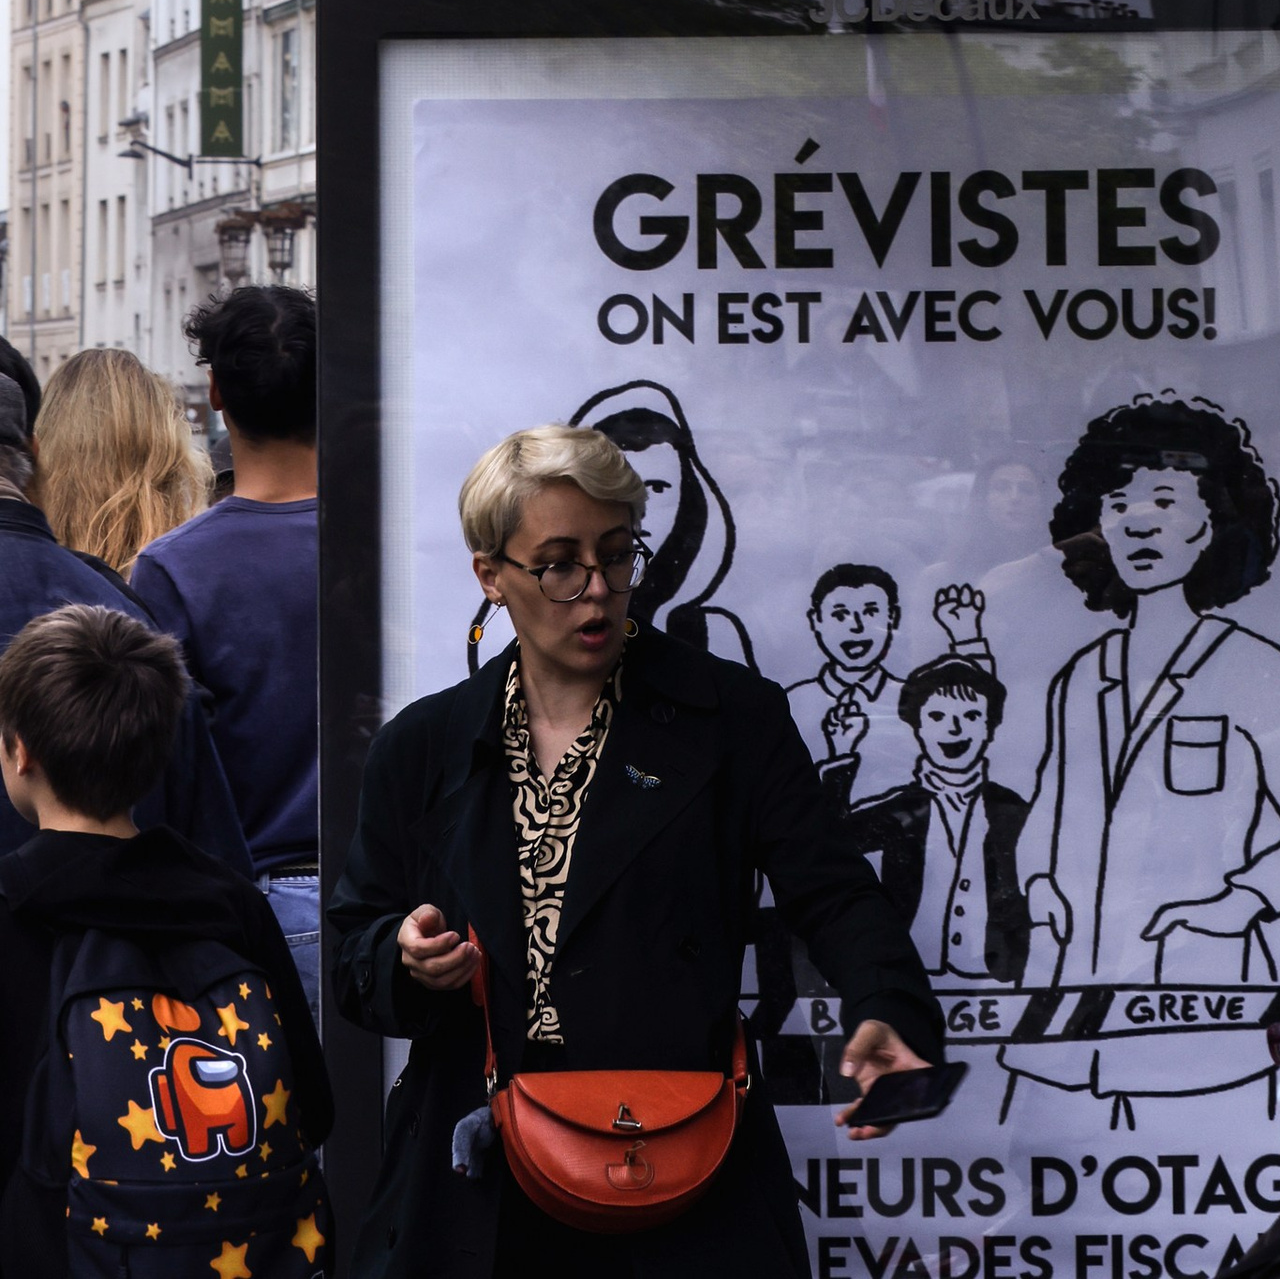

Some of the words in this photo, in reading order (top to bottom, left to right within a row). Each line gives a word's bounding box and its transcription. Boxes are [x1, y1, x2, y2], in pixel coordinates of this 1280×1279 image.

[594, 138, 1219, 270] GRÉVISTES
[598, 293, 694, 344] ON
[718, 292, 821, 344] EST
[843, 290, 1002, 343] AVEC
[1023, 288, 1216, 340] VOUS!
[1124, 993, 1247, 1025] GREVE
[818, 1235, 1054, 1279] EVADES
[1075, 1233, 1268, 1279] FISCA
